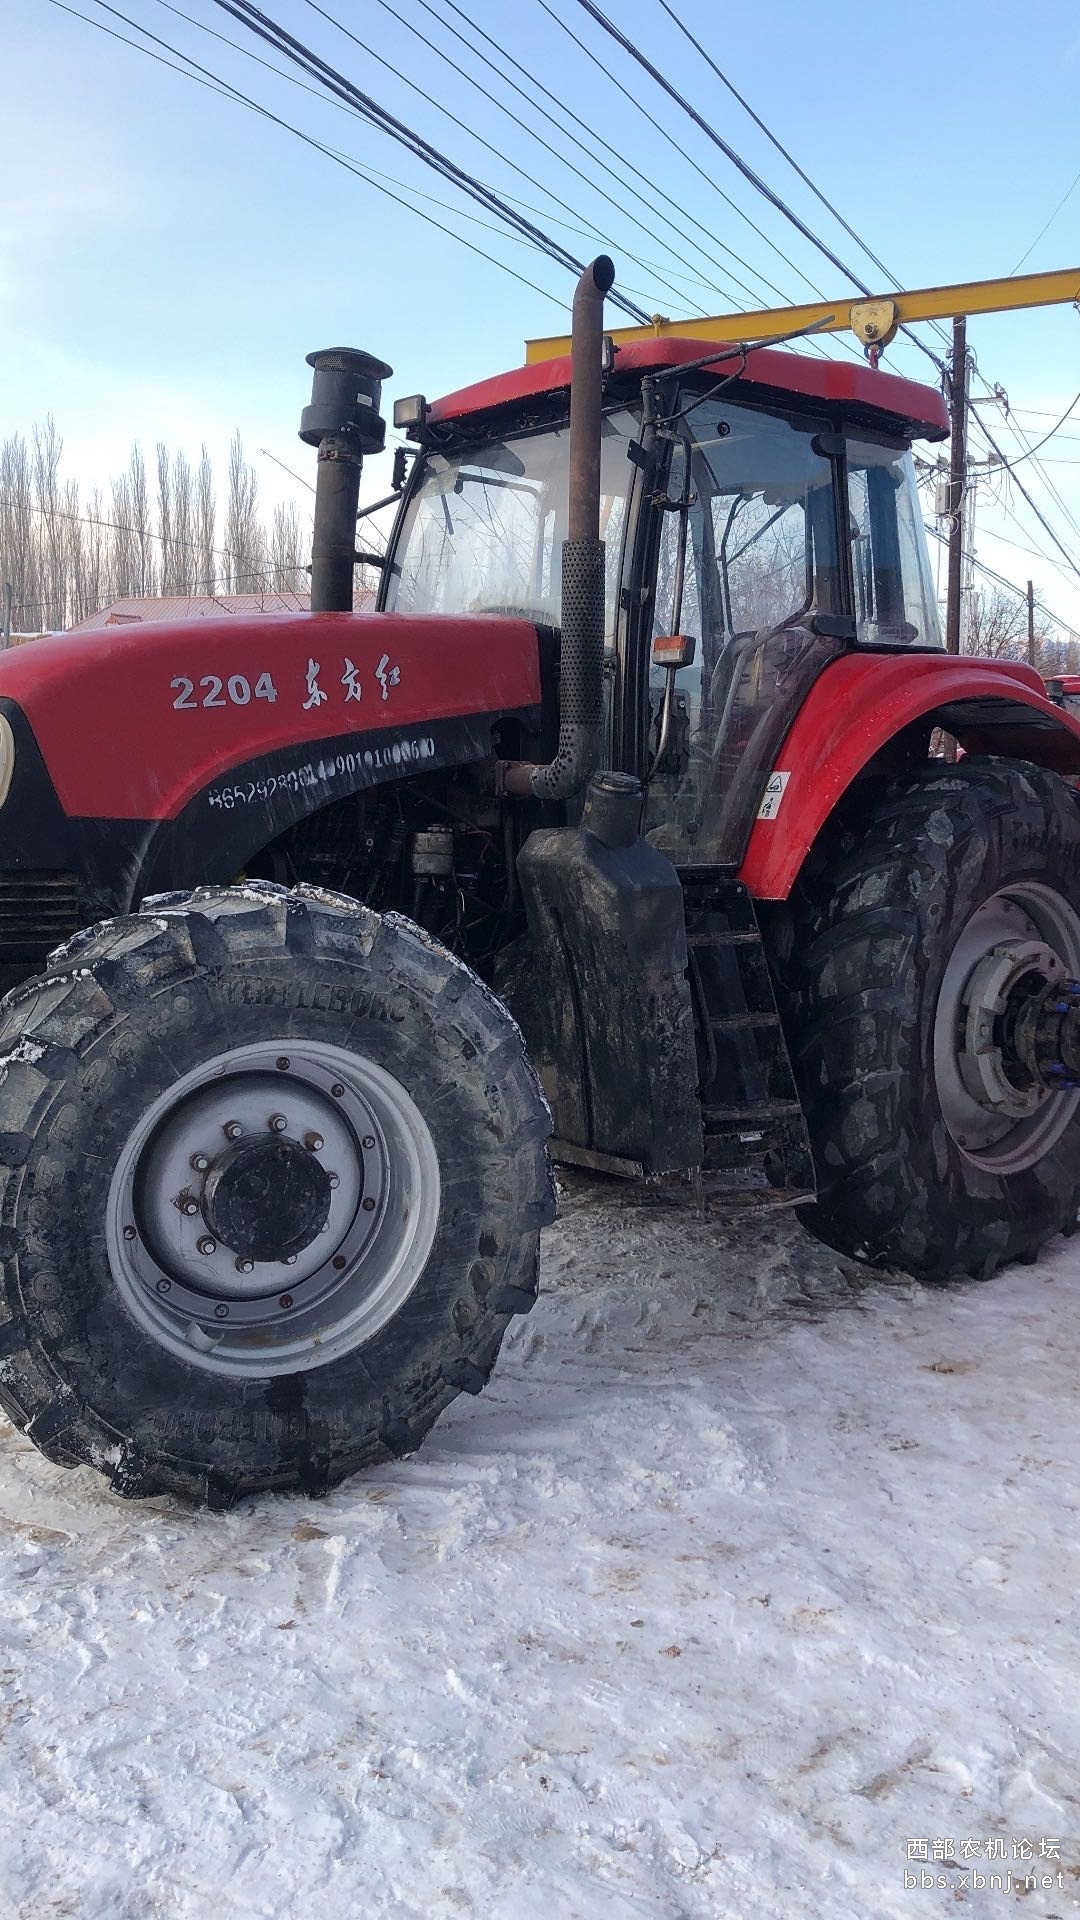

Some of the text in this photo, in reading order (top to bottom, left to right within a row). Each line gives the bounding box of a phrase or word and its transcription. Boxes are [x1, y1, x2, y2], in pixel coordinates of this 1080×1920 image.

[170, 672, 278, 710] 2204
[302, 653, 401, 710] 东方红
